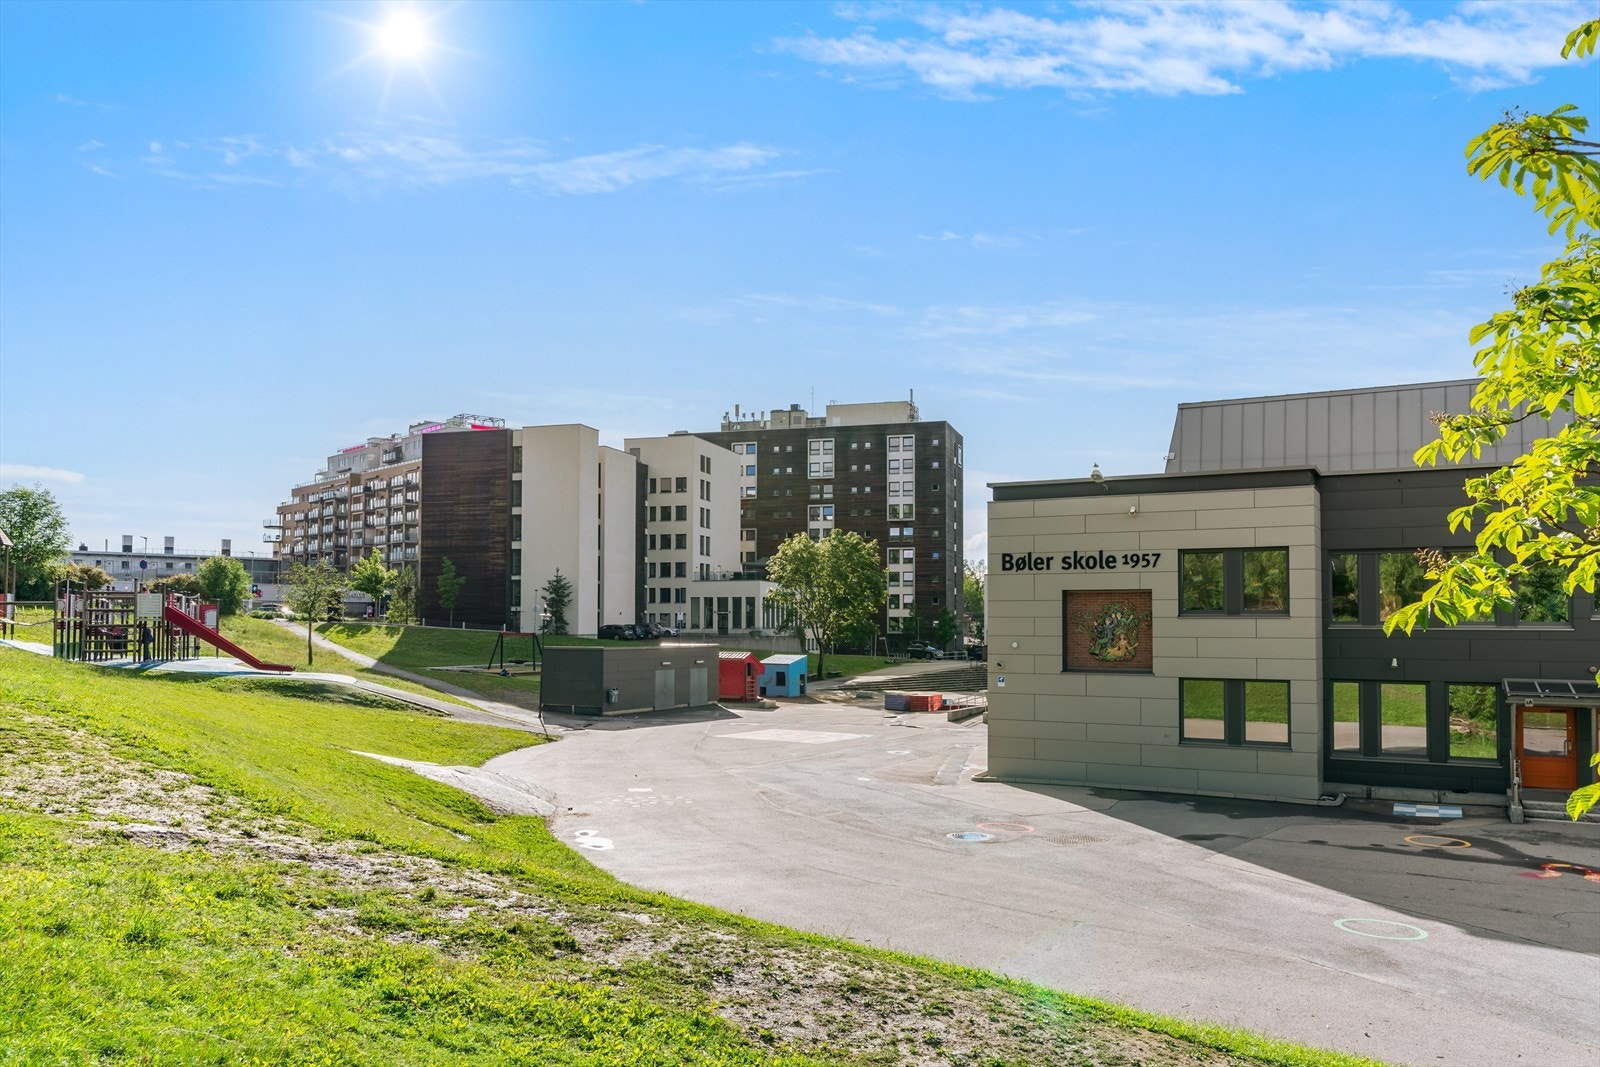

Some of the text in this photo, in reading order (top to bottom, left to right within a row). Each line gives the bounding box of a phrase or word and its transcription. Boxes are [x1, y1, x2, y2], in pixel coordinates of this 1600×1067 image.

[1002, 550, 1161, 571] Bøler skole 1957
